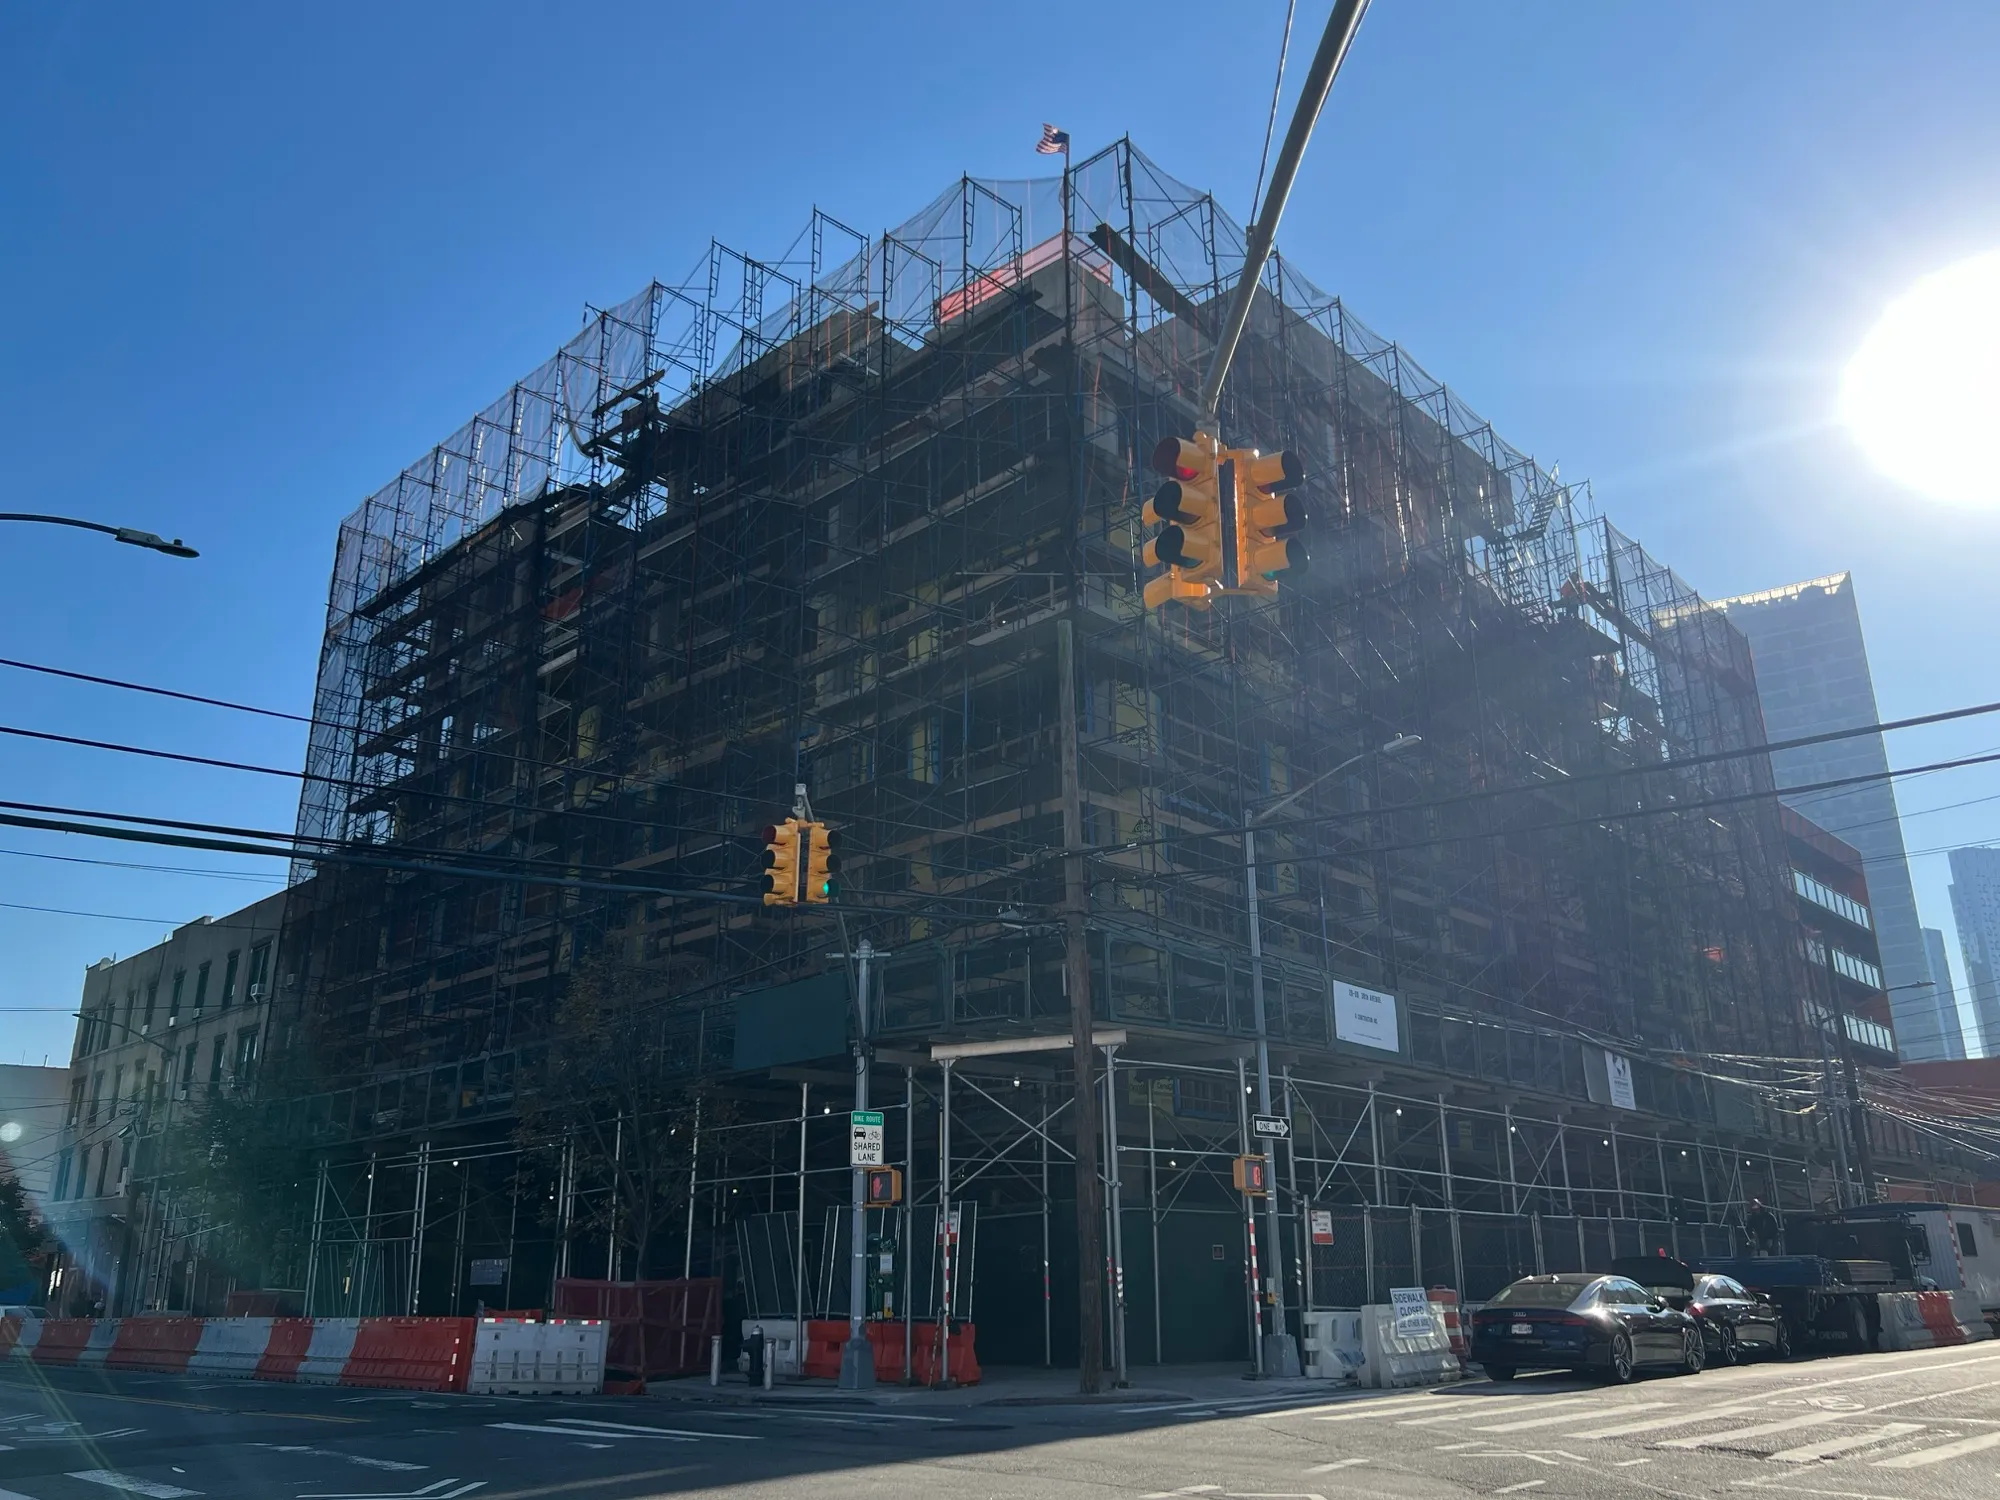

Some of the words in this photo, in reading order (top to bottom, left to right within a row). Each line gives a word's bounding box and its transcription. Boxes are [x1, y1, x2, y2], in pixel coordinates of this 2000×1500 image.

[866, 1115, 881, 1123] ROUTE
[1260, 1122, 1270, 1131] ONE
[1274, 1123, 1286, 1132] WAY
[853, 1142, 880, 1150] SHARED
[858, 1153, 875, 1161] LANE
[1394, 1293, 1425, 1303] SIDEWALK
[1400, 1306, 1424, 1316] CLOSED
